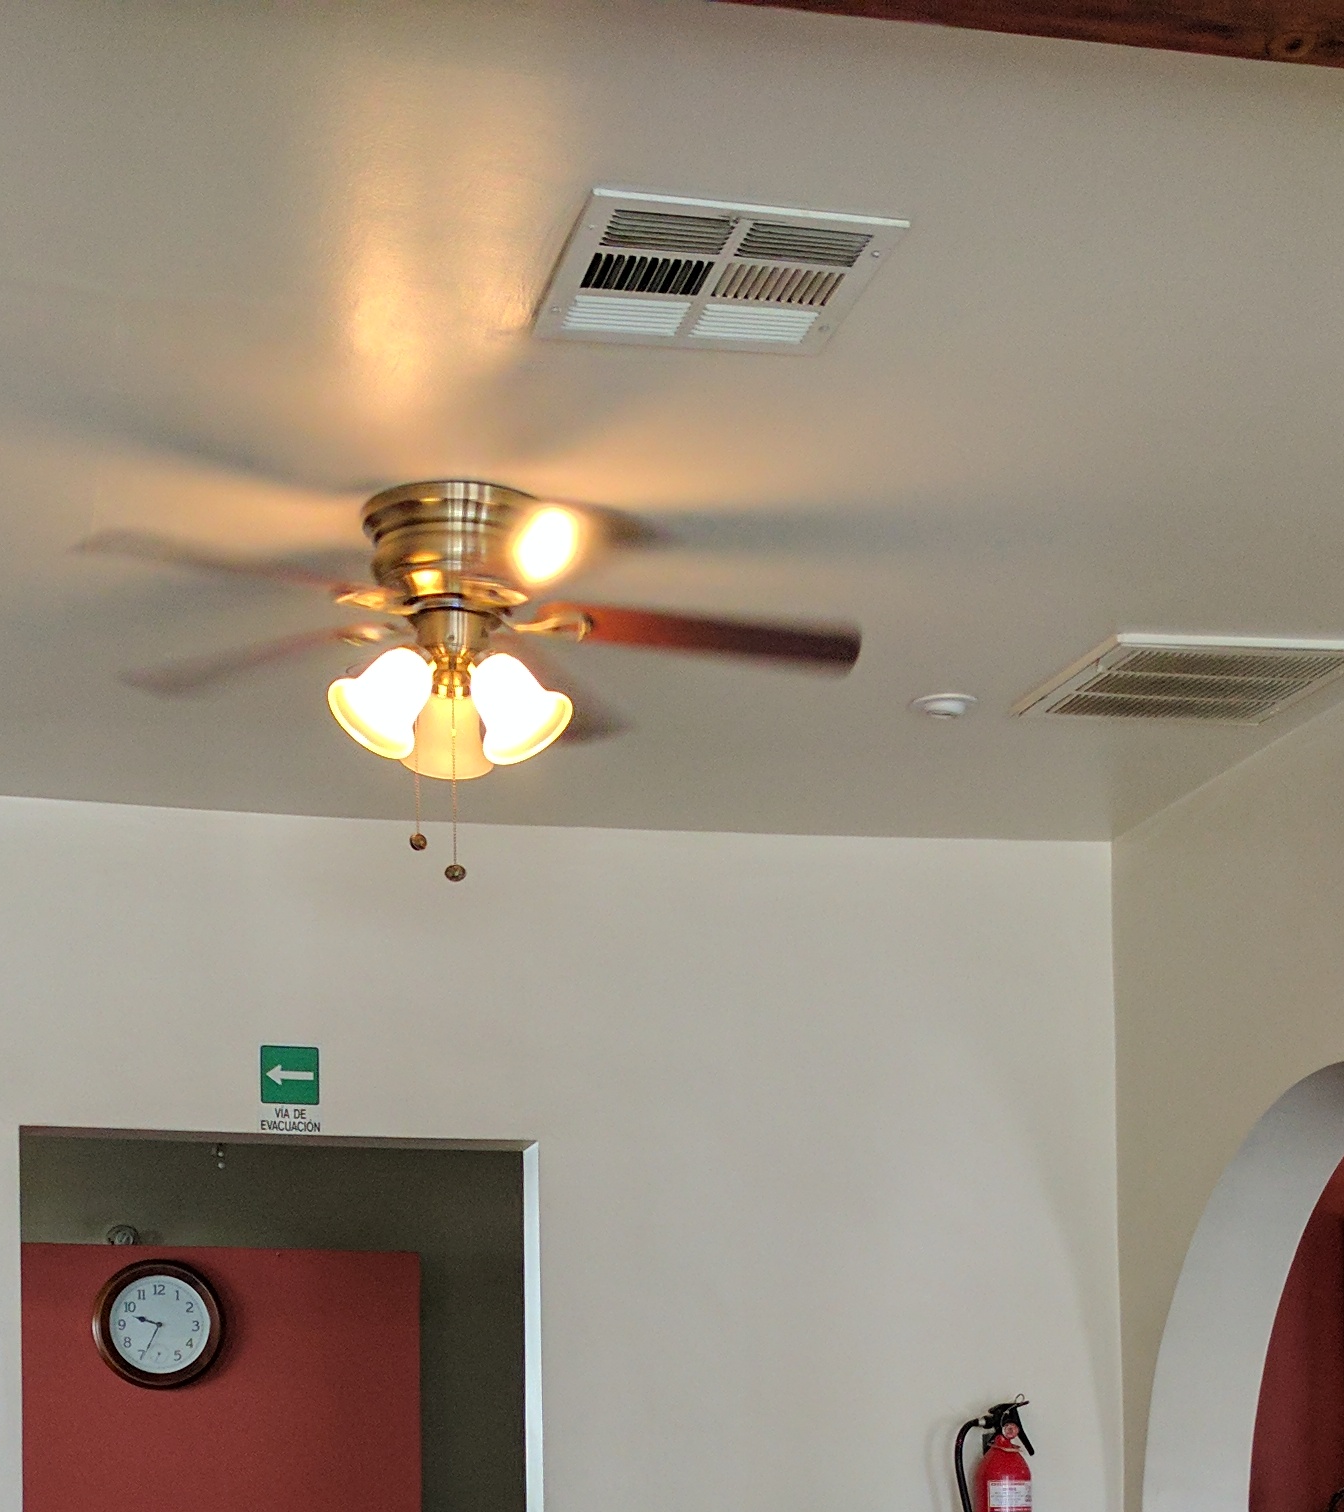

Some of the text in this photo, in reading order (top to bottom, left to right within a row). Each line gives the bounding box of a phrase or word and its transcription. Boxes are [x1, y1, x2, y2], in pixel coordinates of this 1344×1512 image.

[294, 1108, 307, 1120] DE
[261, 1118, 321, 1133] EVACUACIÓN
[137, 1290, 146, 1300] 11
[153, 1284, 166, 1296] 12
[175, 1290, 180, 1301] 1
[124, 1301, 136, 1313] 10
[186, 1302, 194, 1313] 2
[118, 1319, 126, 1330] 9
[192, 1321, 200, 1332] 3
[123, 1337, 131, 1348] 8
[186, 1338, 193, 1348] 4
[138, 1350, 146, 1361] 7
[174, 1350, 182, 1361] 5
